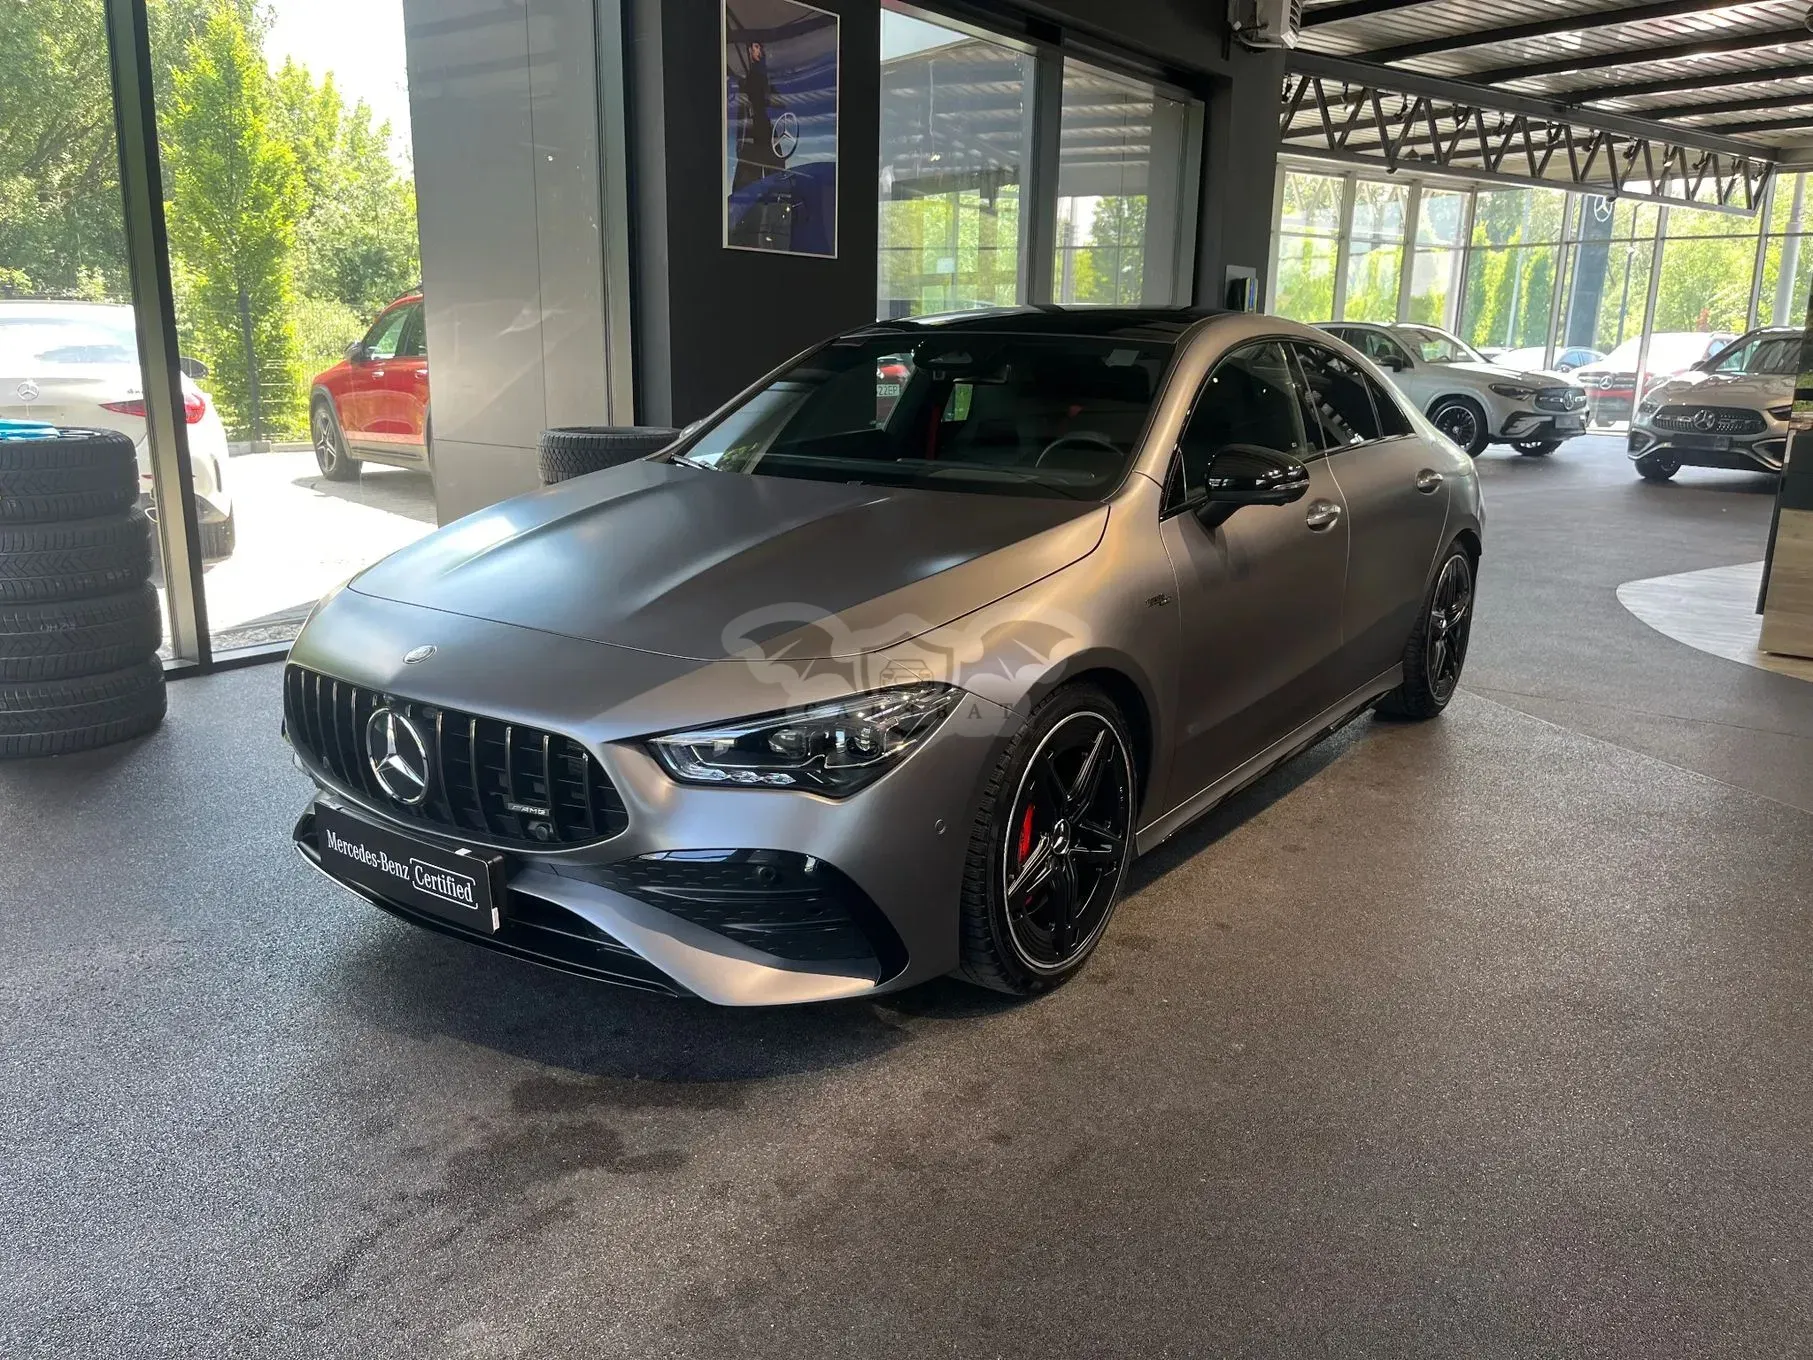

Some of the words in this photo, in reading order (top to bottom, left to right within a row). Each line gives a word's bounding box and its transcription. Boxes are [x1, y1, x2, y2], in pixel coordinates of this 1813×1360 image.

[520, 806, 546, 816] AMG
[326, 829, 410, 880] Mercedes-Benz
[414, 865, 473, 902] Certified
